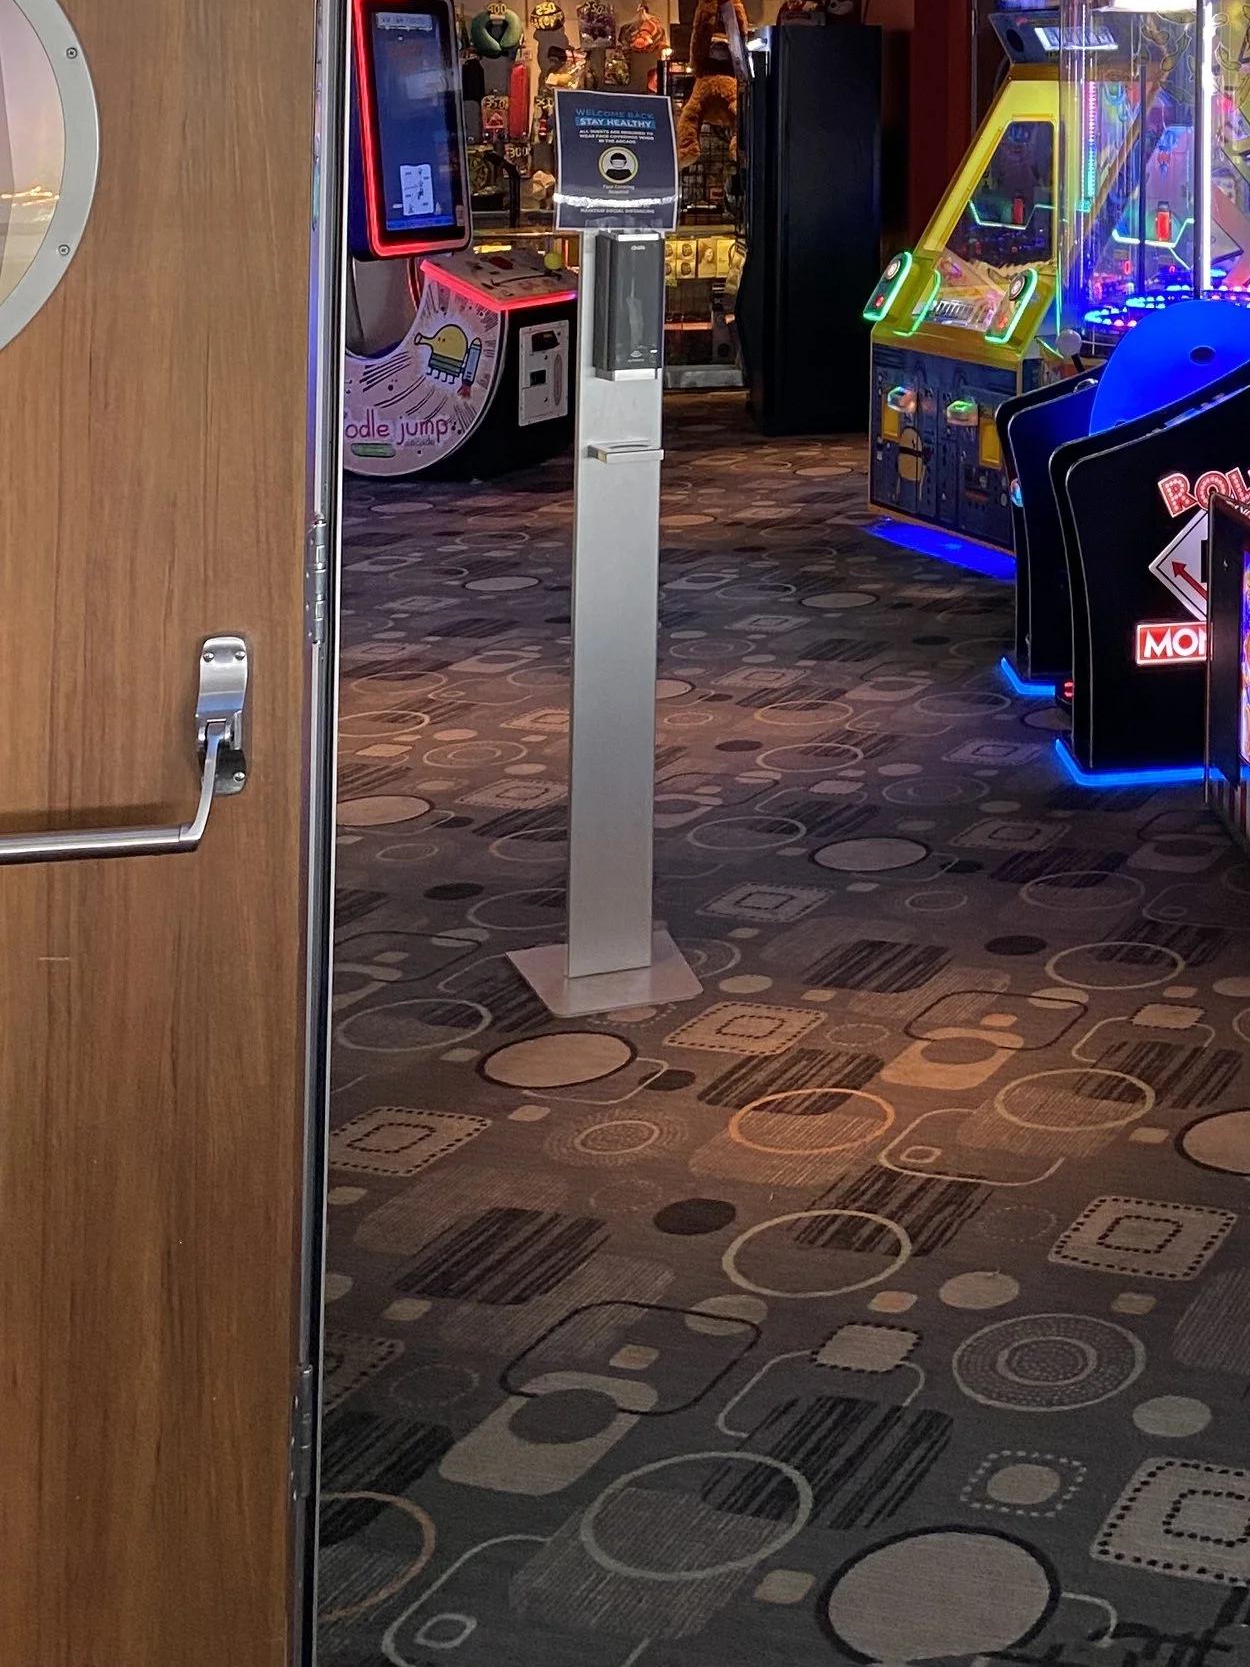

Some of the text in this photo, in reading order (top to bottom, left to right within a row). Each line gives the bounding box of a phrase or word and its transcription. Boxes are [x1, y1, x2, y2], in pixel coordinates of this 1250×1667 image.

[575, 108, 655, 120] WELCOME BACK
[580, 117, 652, 129] STAY HEALTHY
[344, 408, 448, 445] odle jump
